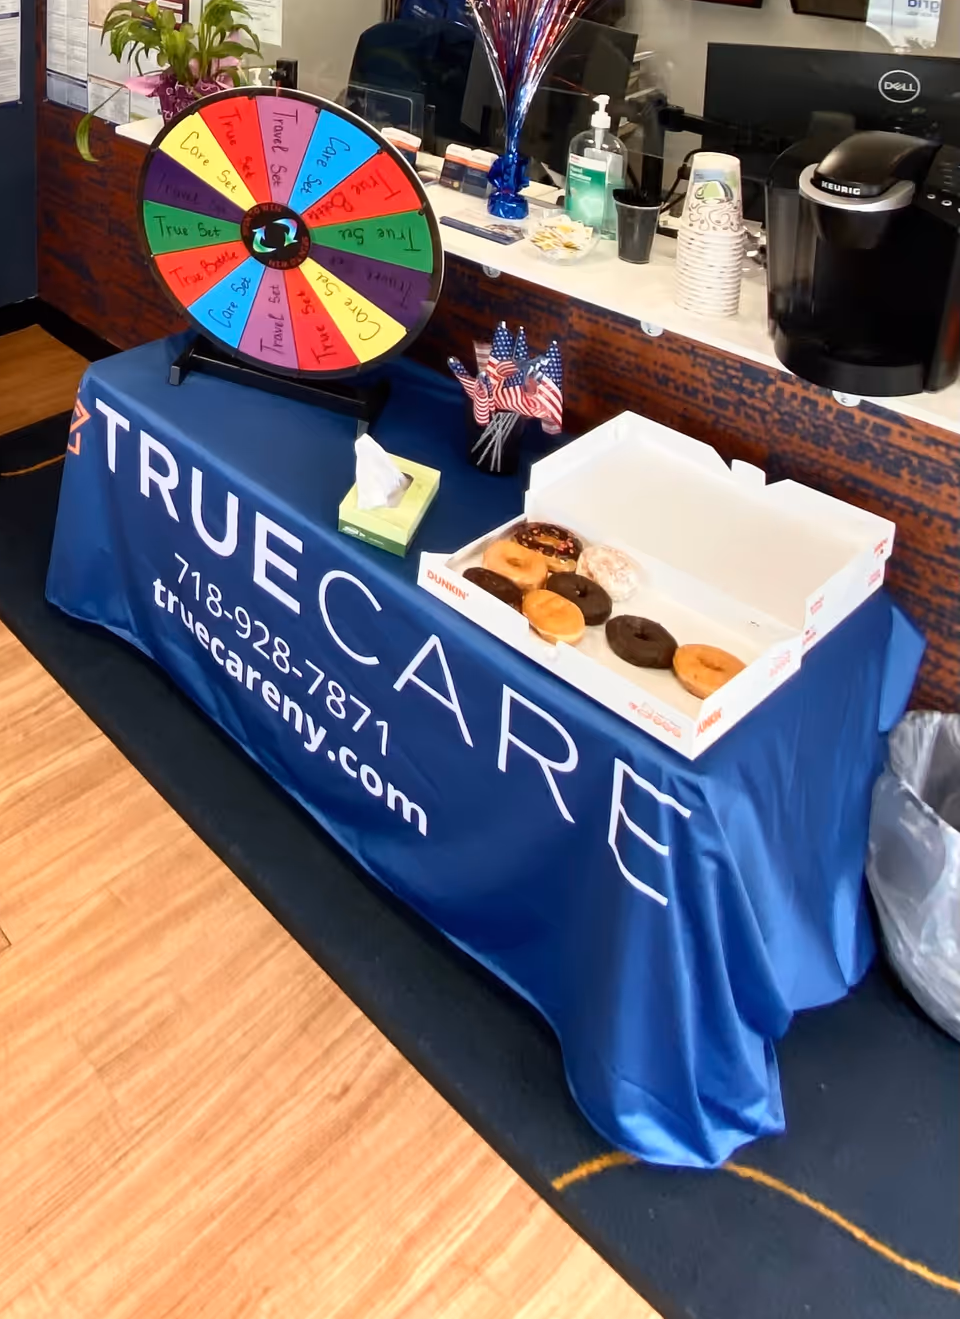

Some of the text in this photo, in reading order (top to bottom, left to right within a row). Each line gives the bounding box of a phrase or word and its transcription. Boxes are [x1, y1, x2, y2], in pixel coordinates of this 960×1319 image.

[884, 81, 916, 92] DELL
[180, 131, 238, 193] Care Set
[218, 106, 256, 180] True Set
[270, 108, 299, 187] Travel Set
[300, 136, 351, 194] Care Set
[307, 168, 402, 221] True Bottle
[821, 180, 861, 196] KEURIG
[153, 215, 189, 238] True
[197, 222, 223, 238] Set
[376, 226, 422, 253] True
[169, 251, 239, 288] True Bottle
[208, 277, 252, 329] Care Set
[259, 284, 286, 355] Travel Set
[343, 297, 381, 341] Care
[310, 324, 338, 365] True
[95, 398, 692, 907] TRUECARE
[173, 552, 390, 757] 718-928-7871
[152, 575, 429, 837] truecareny.com
